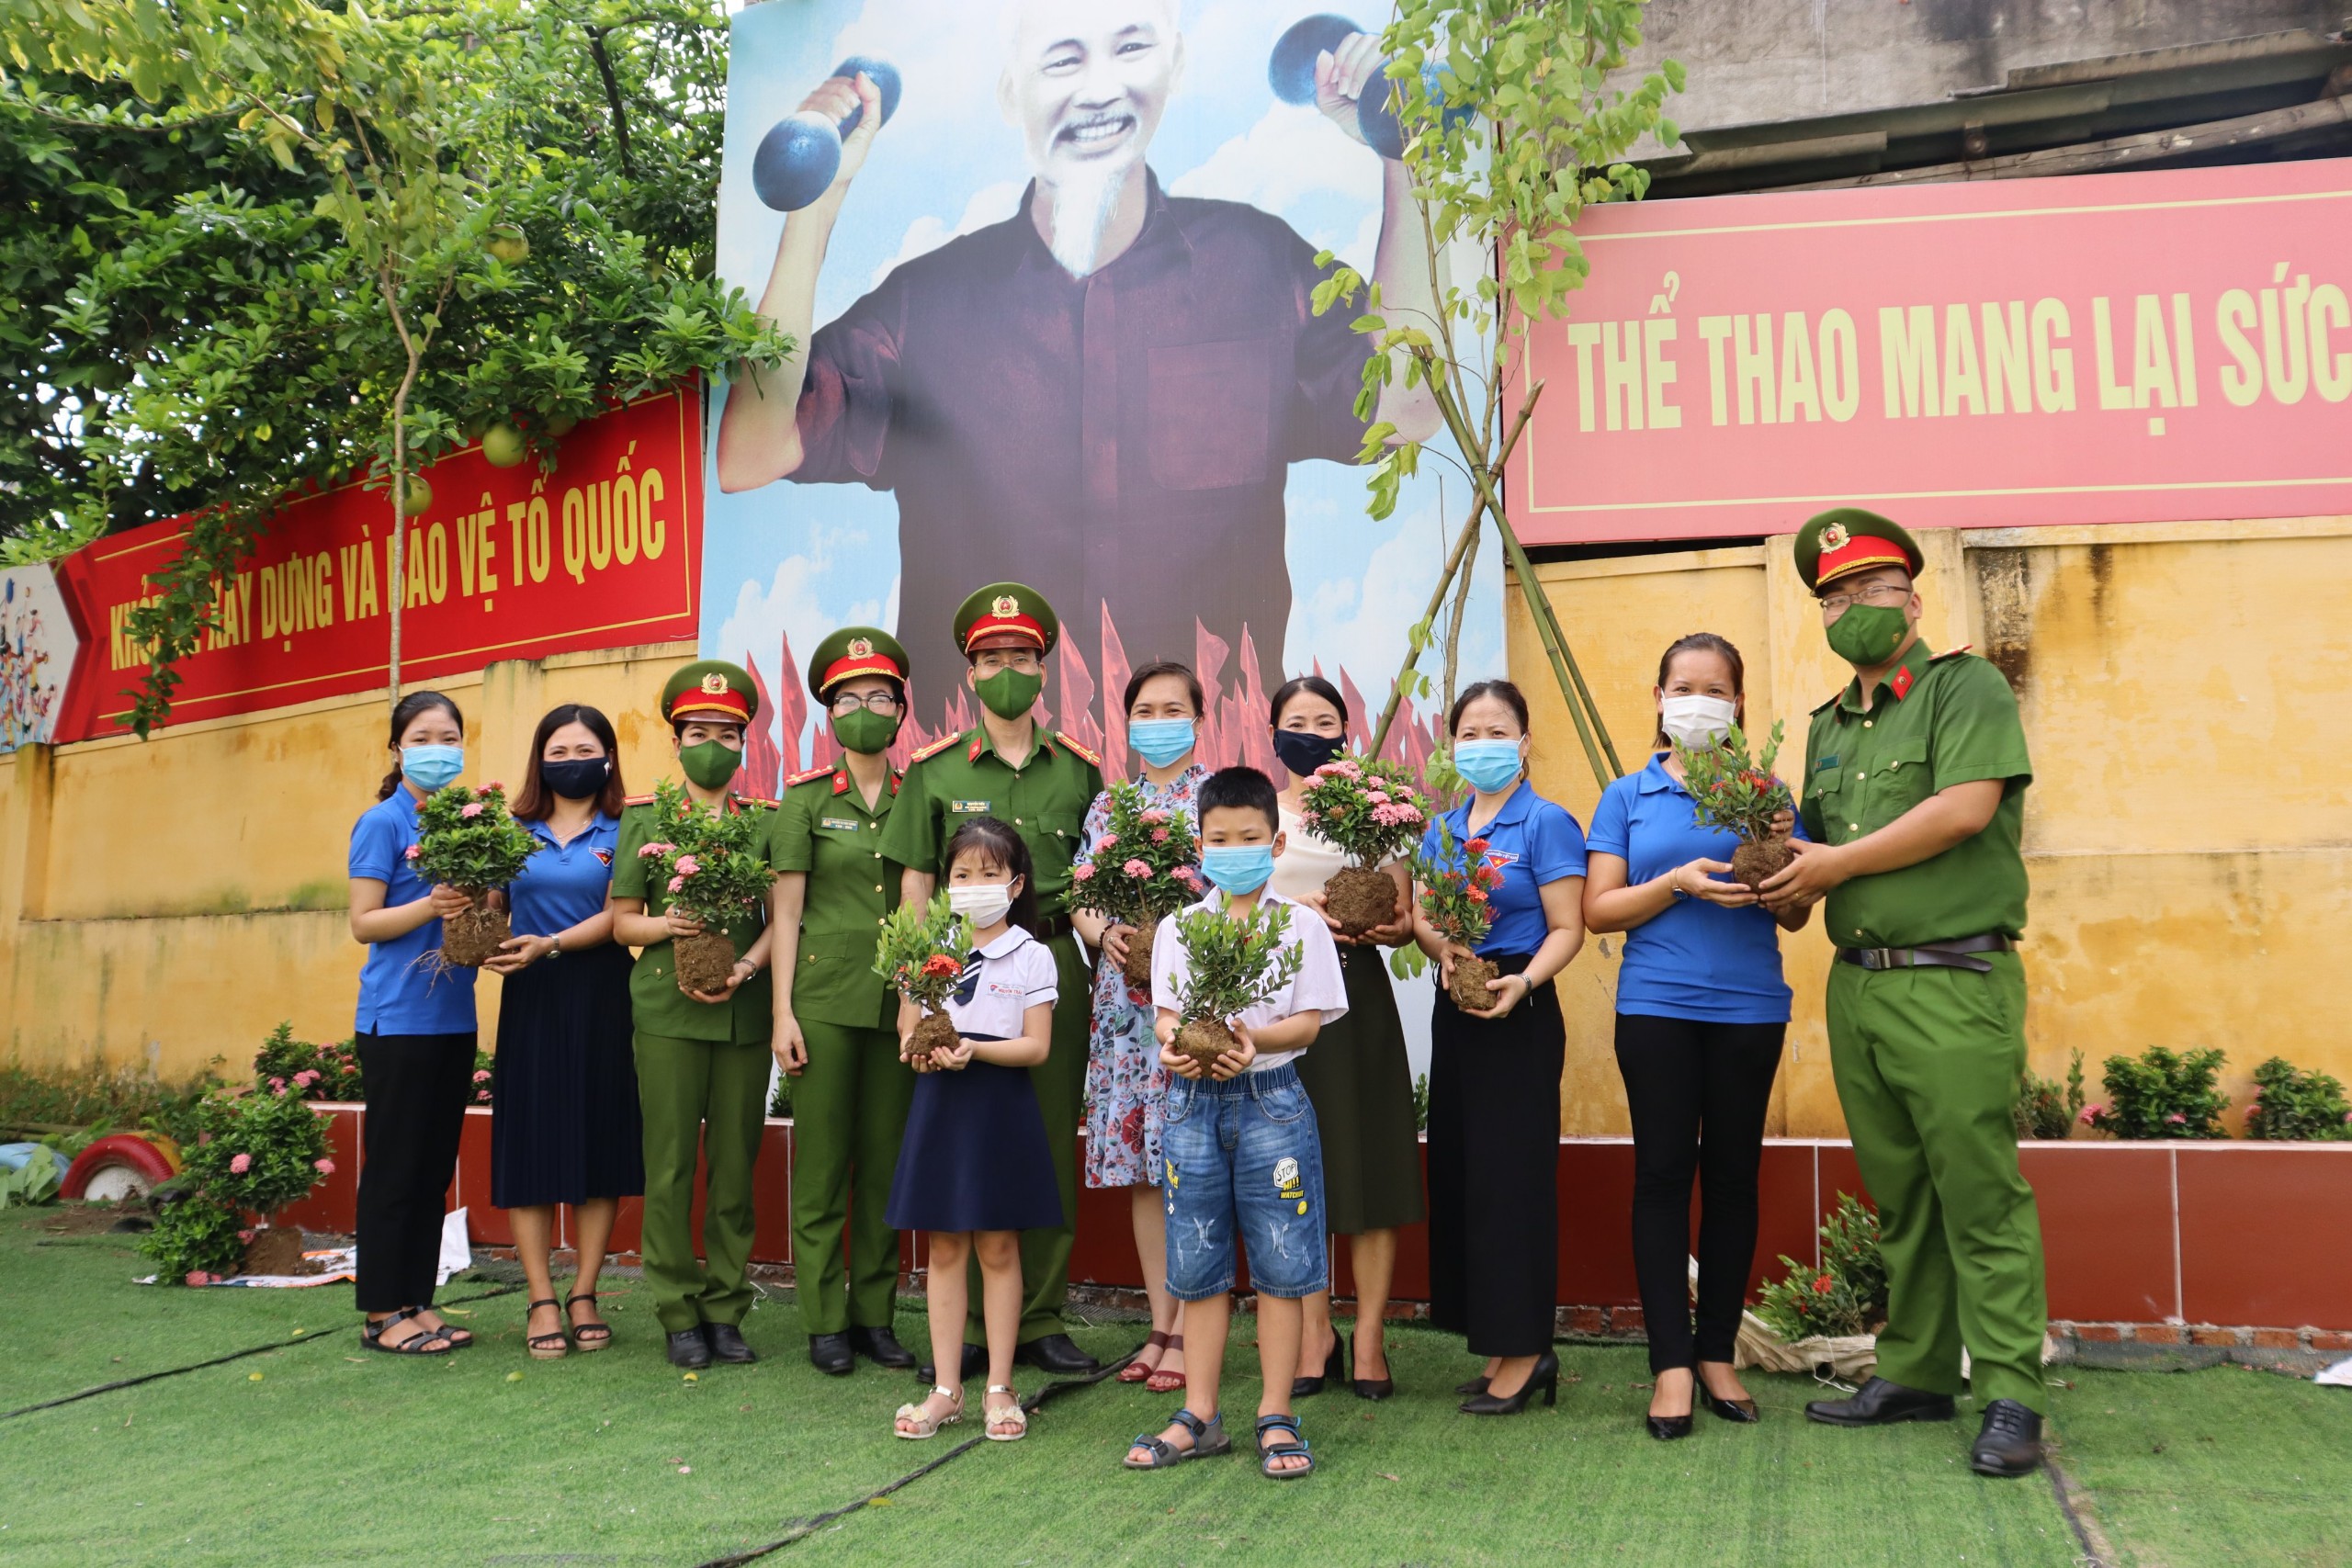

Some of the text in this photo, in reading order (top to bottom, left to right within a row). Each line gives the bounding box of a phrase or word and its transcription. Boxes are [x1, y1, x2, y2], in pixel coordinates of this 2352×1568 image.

[1567, 261, 2352, 436] THỂ THAO MANG LẠI SỨC
[261, 551, 334, 653] DỰNG
[340, 524, 379, 623] VÀ
[457, 491, 498, 613] VỆ
[507, 460, 550, 587] TỔ
[562, 440, 666, 585] QUỐC
[1277, 1163, 1296, 1182] STOP
